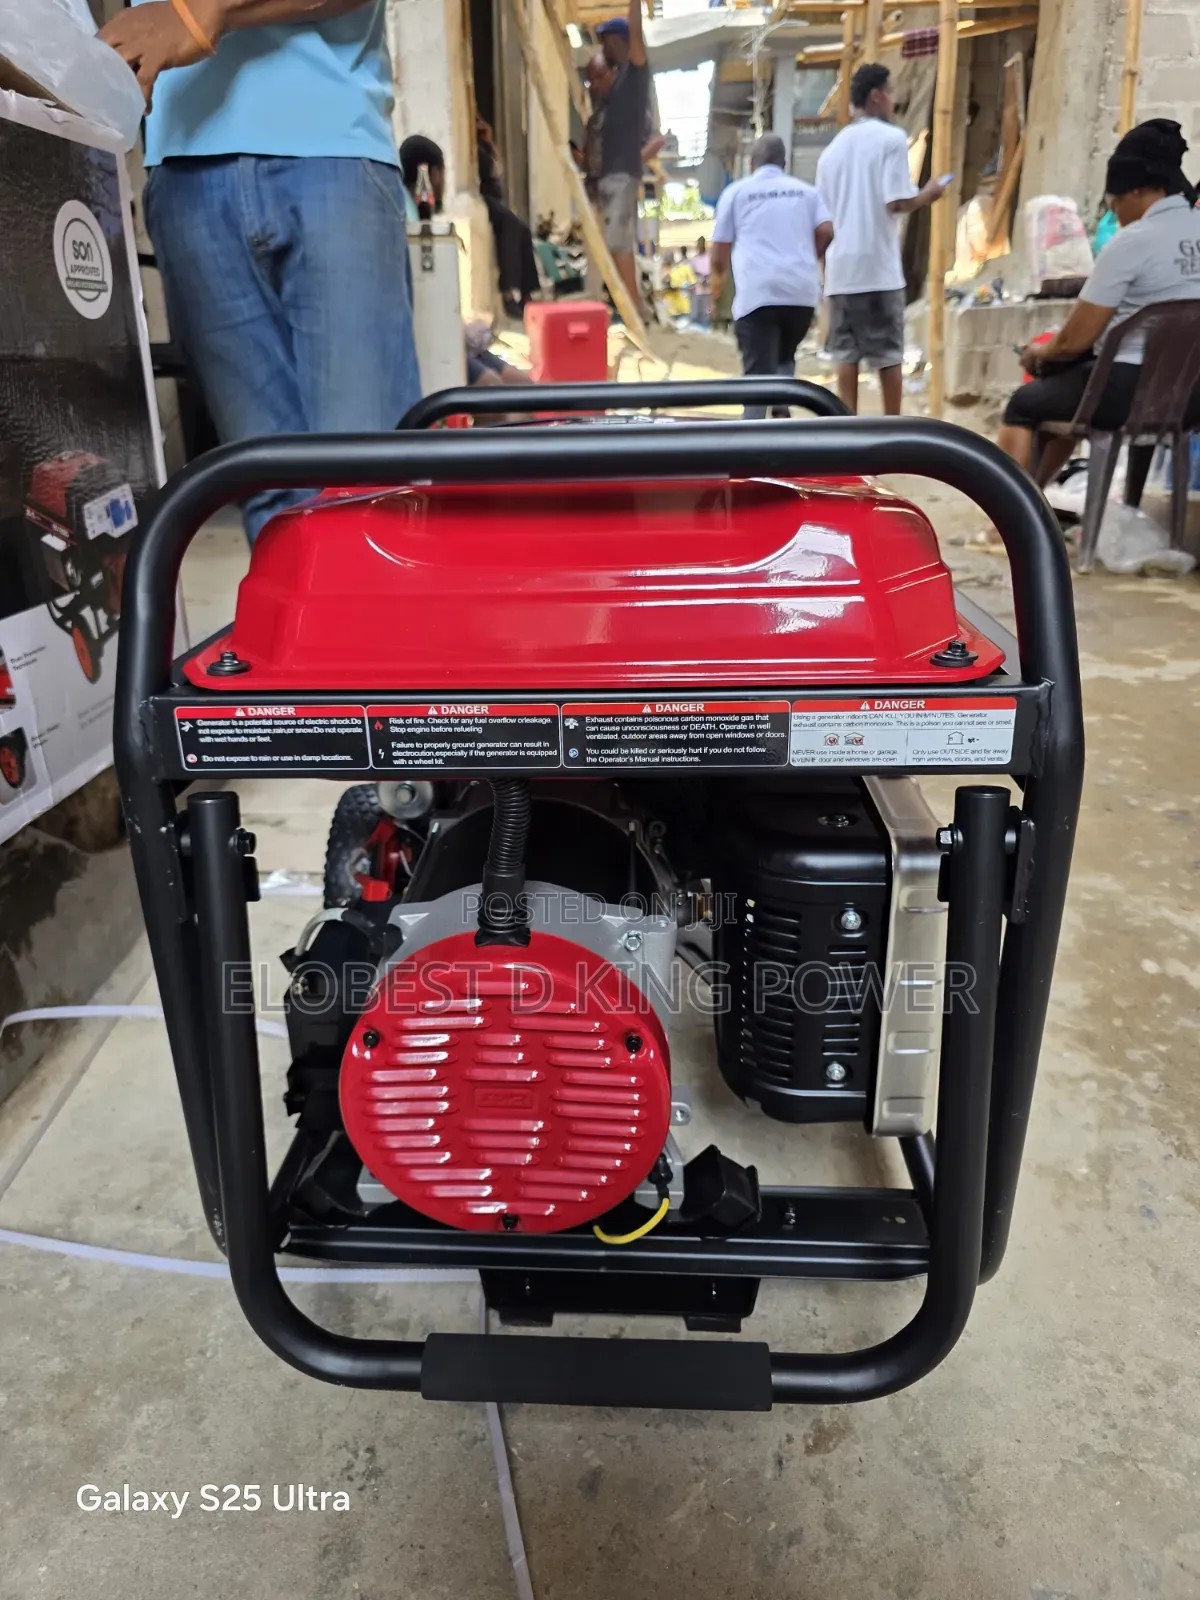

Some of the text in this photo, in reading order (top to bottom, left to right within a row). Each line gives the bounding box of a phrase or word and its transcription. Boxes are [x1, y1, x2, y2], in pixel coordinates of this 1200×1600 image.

[655, 703, 705, 713] DANGER
[874, 700, 926, 710] DANGER
[247, 707, 296, 716] DANGER
[441, 706, 489, 715] DANGER
[389, 726, 406, 734] Stop
[719, 723, 748, 731] Operate
[476, 741, 508, 749] generator
[598, 756, 634, 764] Operator's
